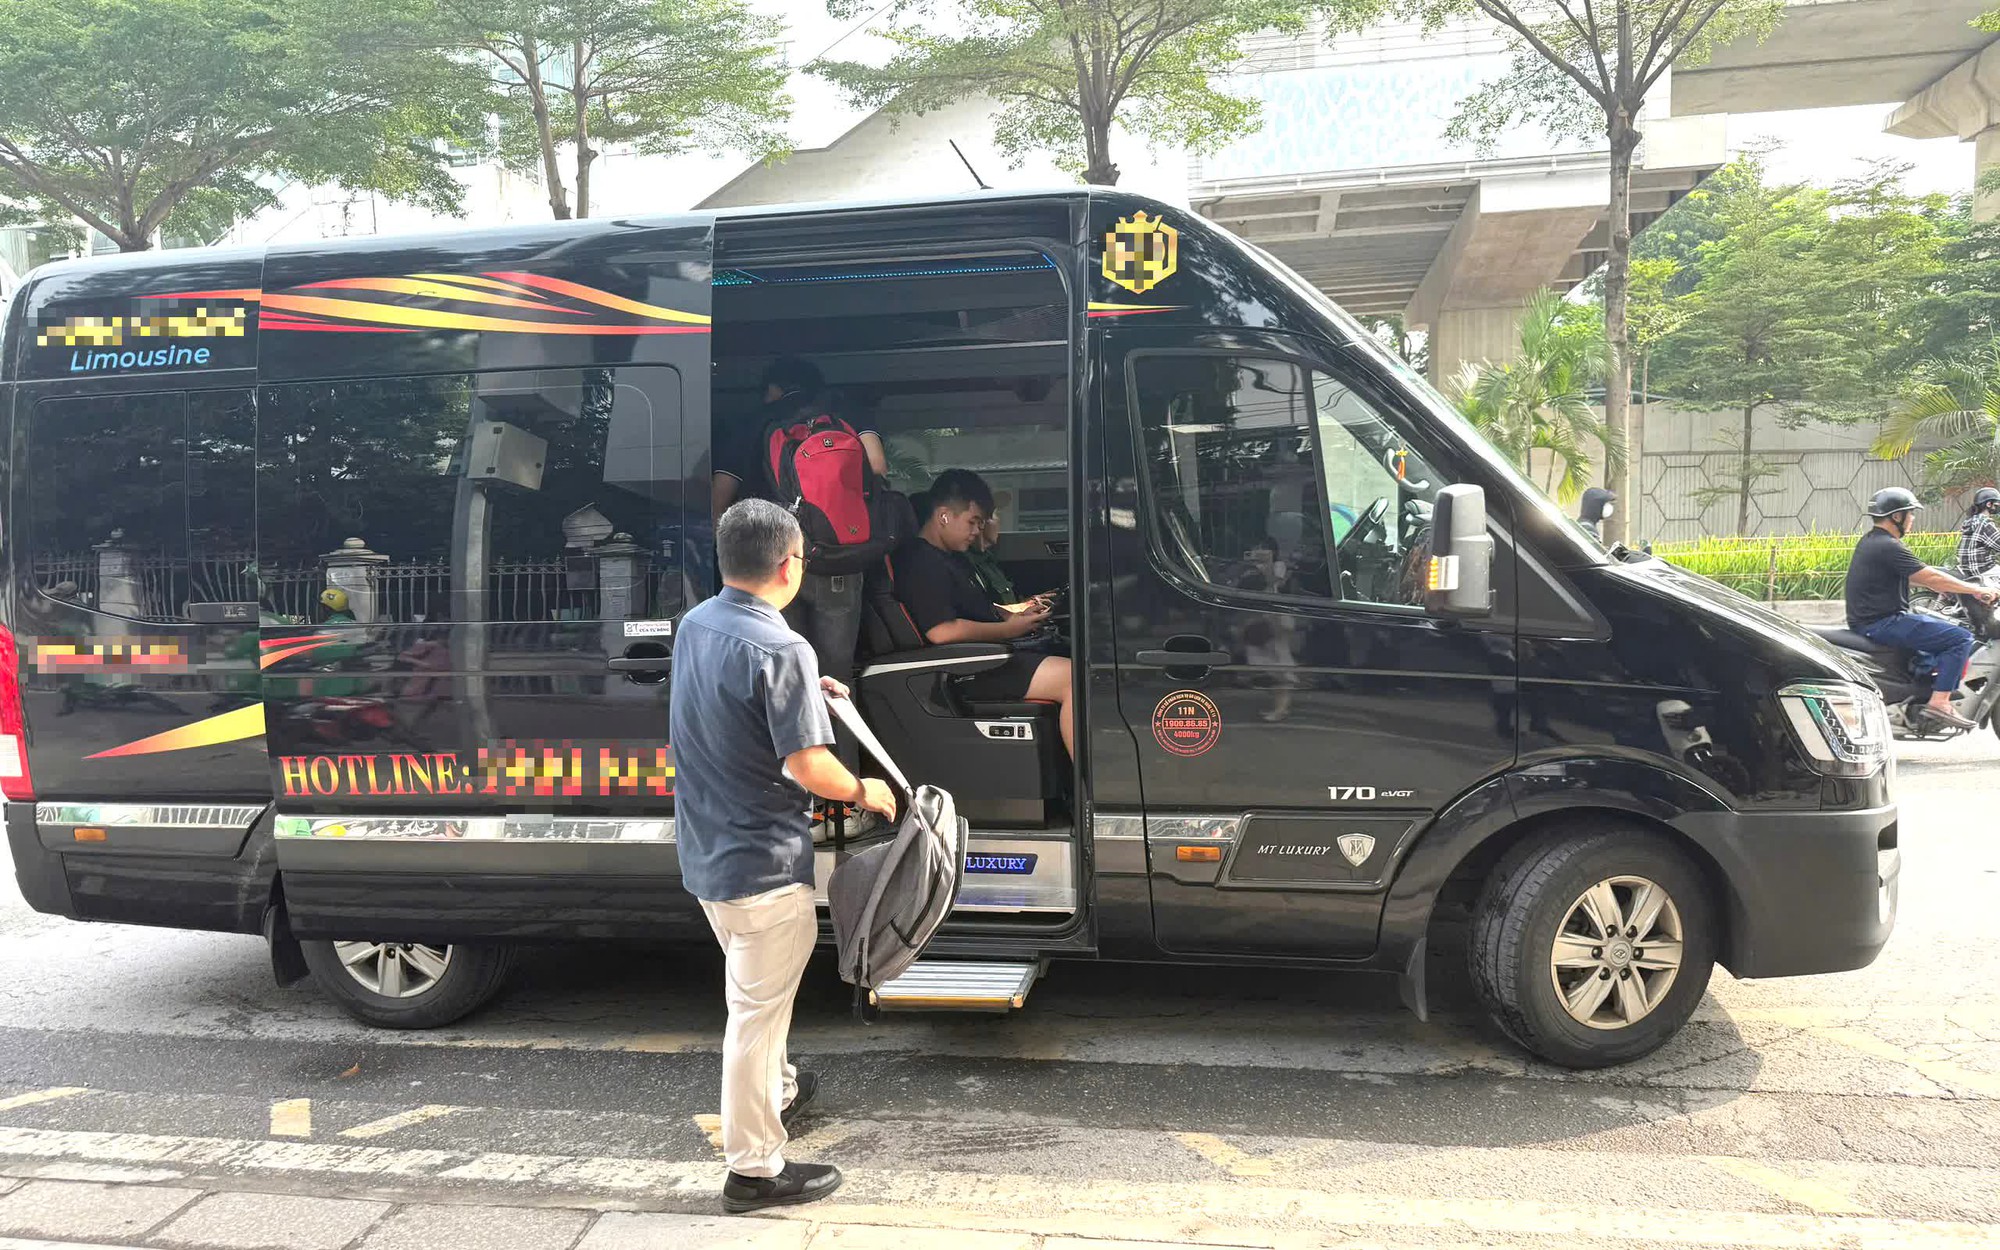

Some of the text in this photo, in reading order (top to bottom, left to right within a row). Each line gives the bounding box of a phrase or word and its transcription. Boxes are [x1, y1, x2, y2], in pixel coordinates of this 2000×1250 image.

[70, 345, 210, 372] Limousine
[1178, 707, 1195, 715] 11N
[279, 753, 474, 796] HOTLINE:
[1328, 786, 1376, 800] 170
[1258, 845, 1330, 855] MT LUXURY
[966, 857, 1027, 869] LUXURY
